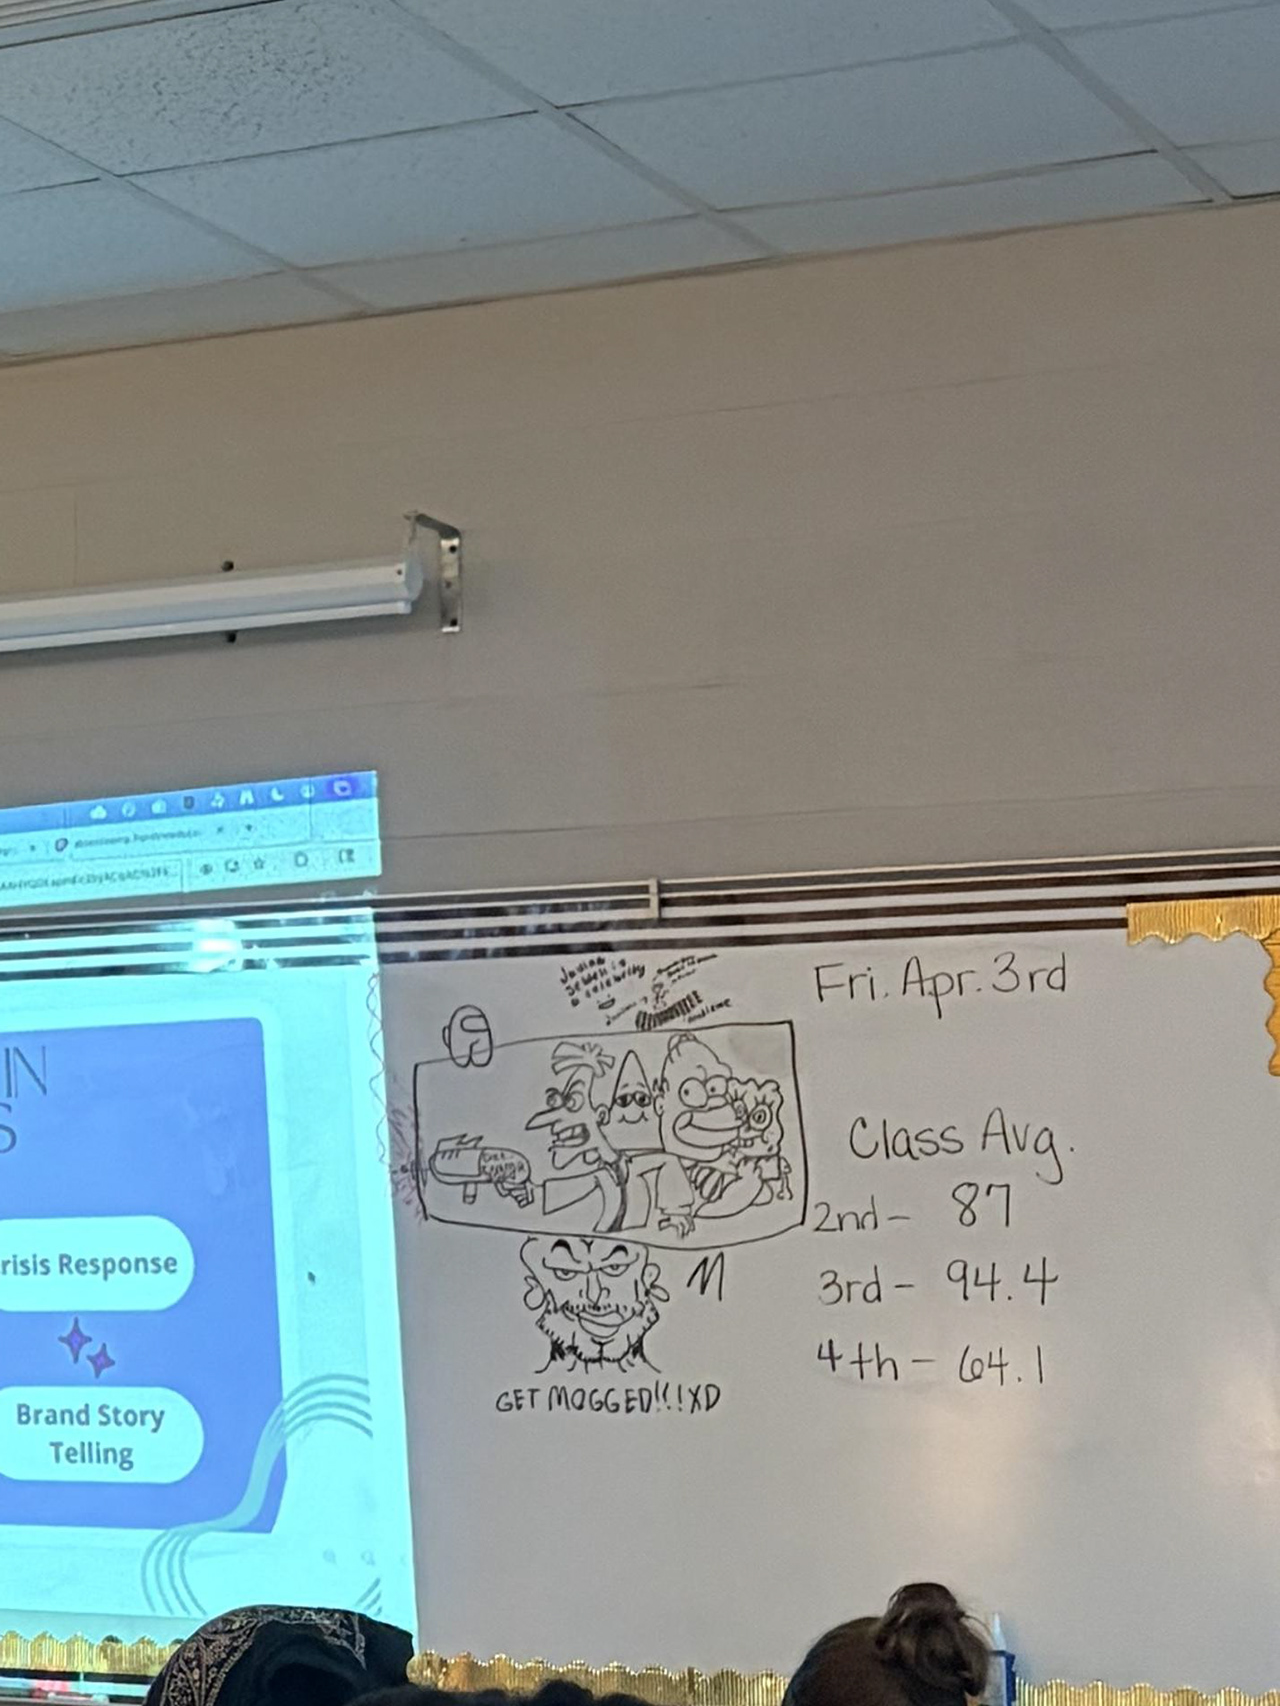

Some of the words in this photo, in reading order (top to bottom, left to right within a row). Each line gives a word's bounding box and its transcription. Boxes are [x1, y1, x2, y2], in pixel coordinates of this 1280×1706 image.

[814, 963, 889, 1002] Fri.
[902, 955, 982, 1019] Apr.
[992, 951, 1066, 993] 3rd
[4, 1046, 48, 1098] IN
[849, 1116, 964, 1160] Class
[982, 1107, 1075, 1185] Avg.
[952, 1182, 1010, 1227] 87
[58, 1253, 178, 1281] Response
[819, 1264, 882, 1305] 3rd
[947, 1257, 1059, 1306] 94.4
[817, 1339, 898, 1381] 4th
[959, 1344, 1043, 1386] 64.1
[16, 1402, 91, 1427] Brand
[97, 1404, 165, 1433] Story
[495, 1388, 541, 1413] GET
[49, 1441, 134, 1471] Telling
